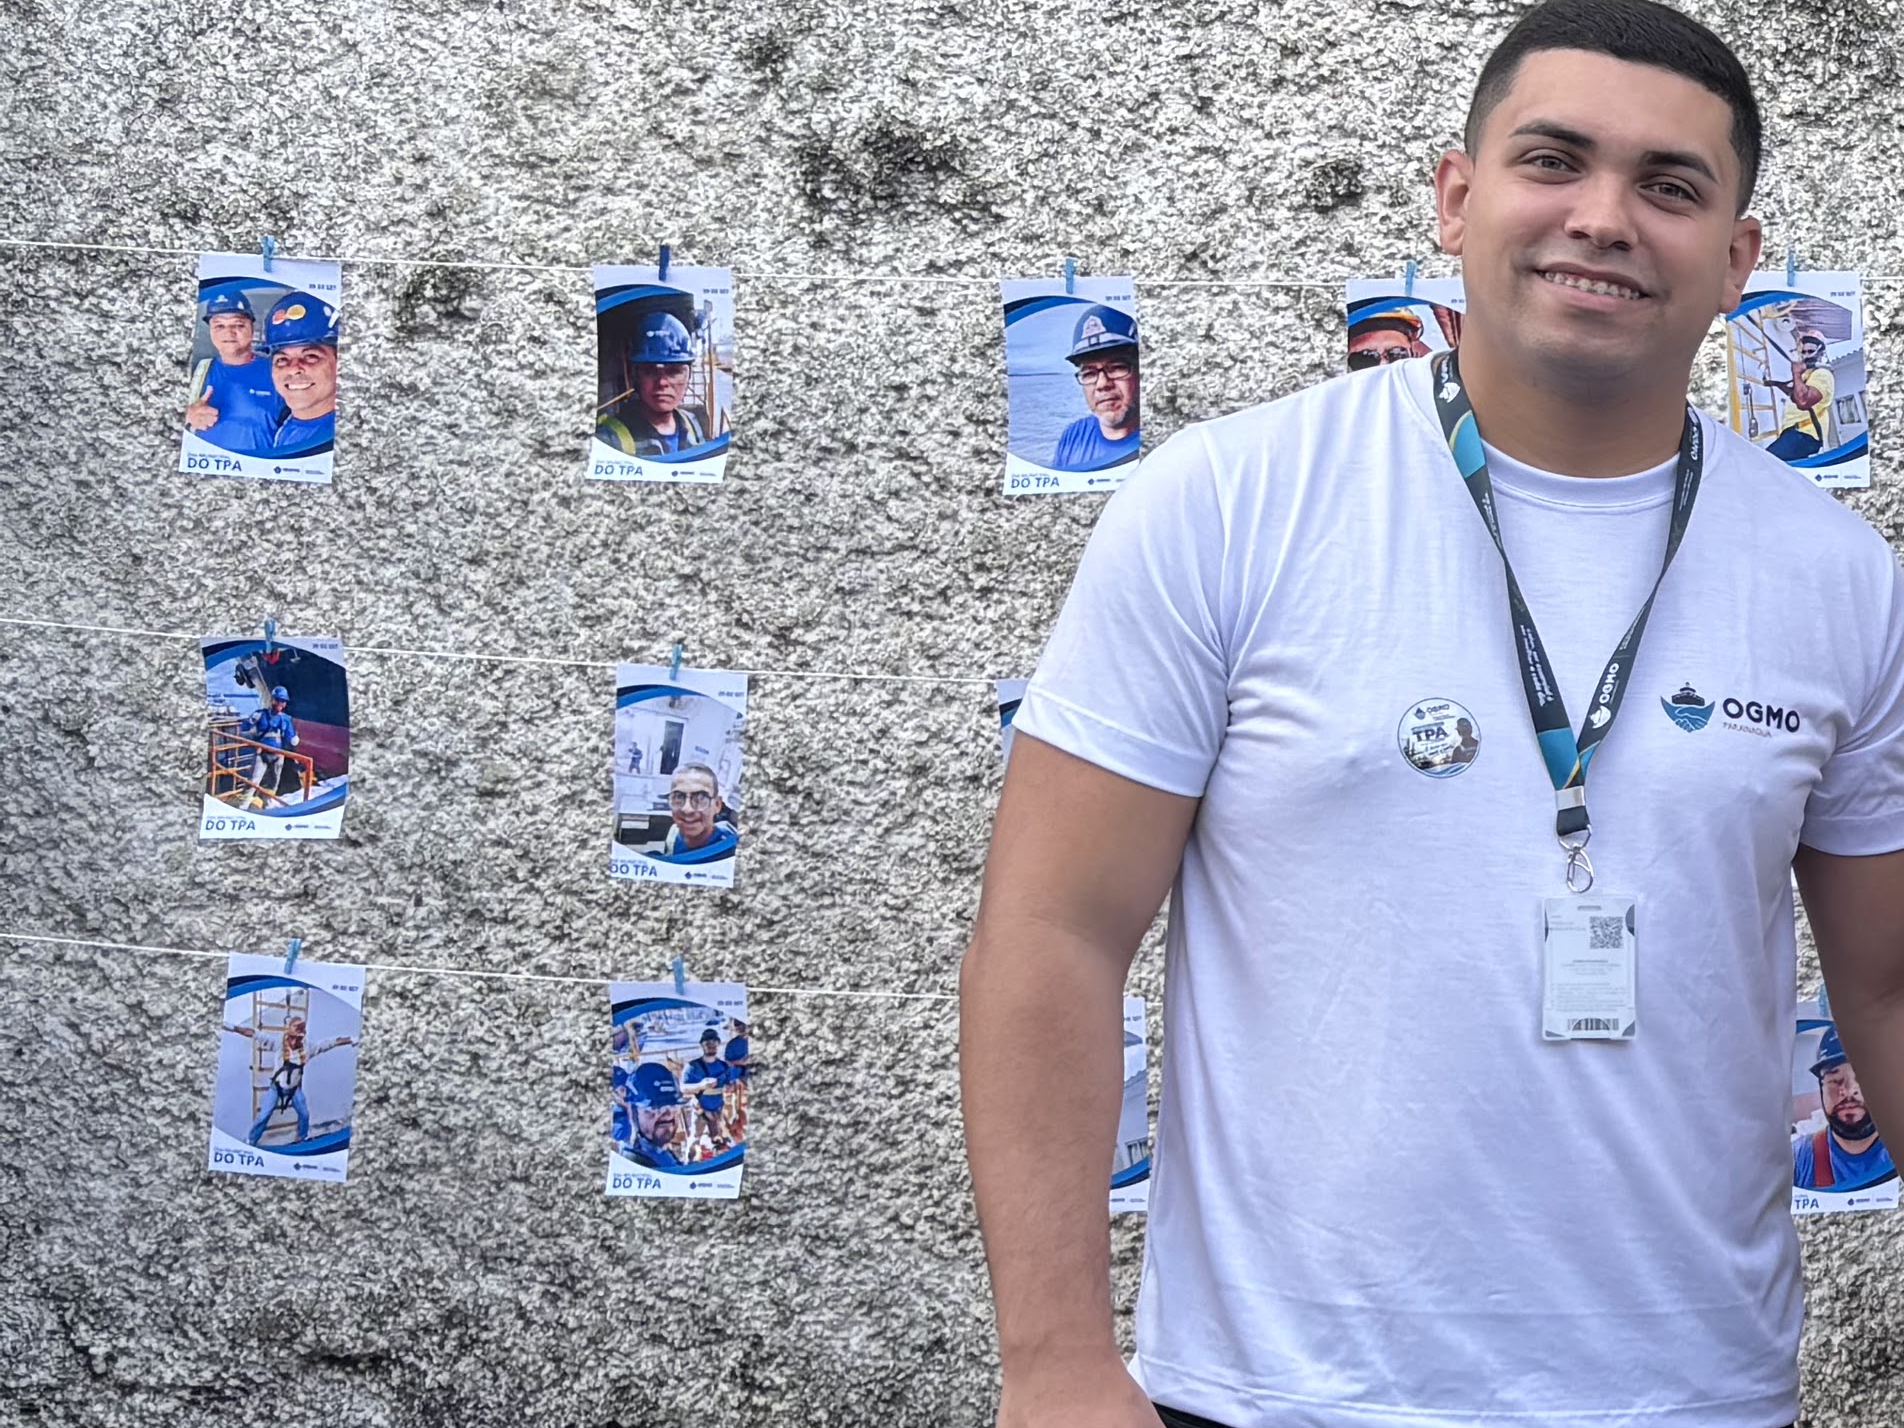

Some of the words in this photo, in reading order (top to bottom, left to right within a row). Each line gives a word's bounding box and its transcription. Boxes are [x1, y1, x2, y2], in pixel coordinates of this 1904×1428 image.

[188, 458, 209, 469] DO
[216, 459, 242, 472] TPA
[595, 465, 613, 475] DO
[619, 465, 643, 476] TPA
[1011, 478, 1030, 488] DO
[1036, 477, 1059, 487] TPA
[1599, 663, 1619, 704] OGMO
[1722, 698, 1800, 732] OGMO
[1412, 727, 1449, 742] TPA
[206, 820, 226, 830] DO
[231, 821, 255, 830] TPA
[633, 864, 657, 876] TPA
[214, 1153, 234, 1163] DO
[239, 1154, 264, 1167] TPA
[613, 1178, 632, 1189] DO
[637, 1178, 661, 1189] TPA
[1795, 1198, 1819, 1209] TPA
